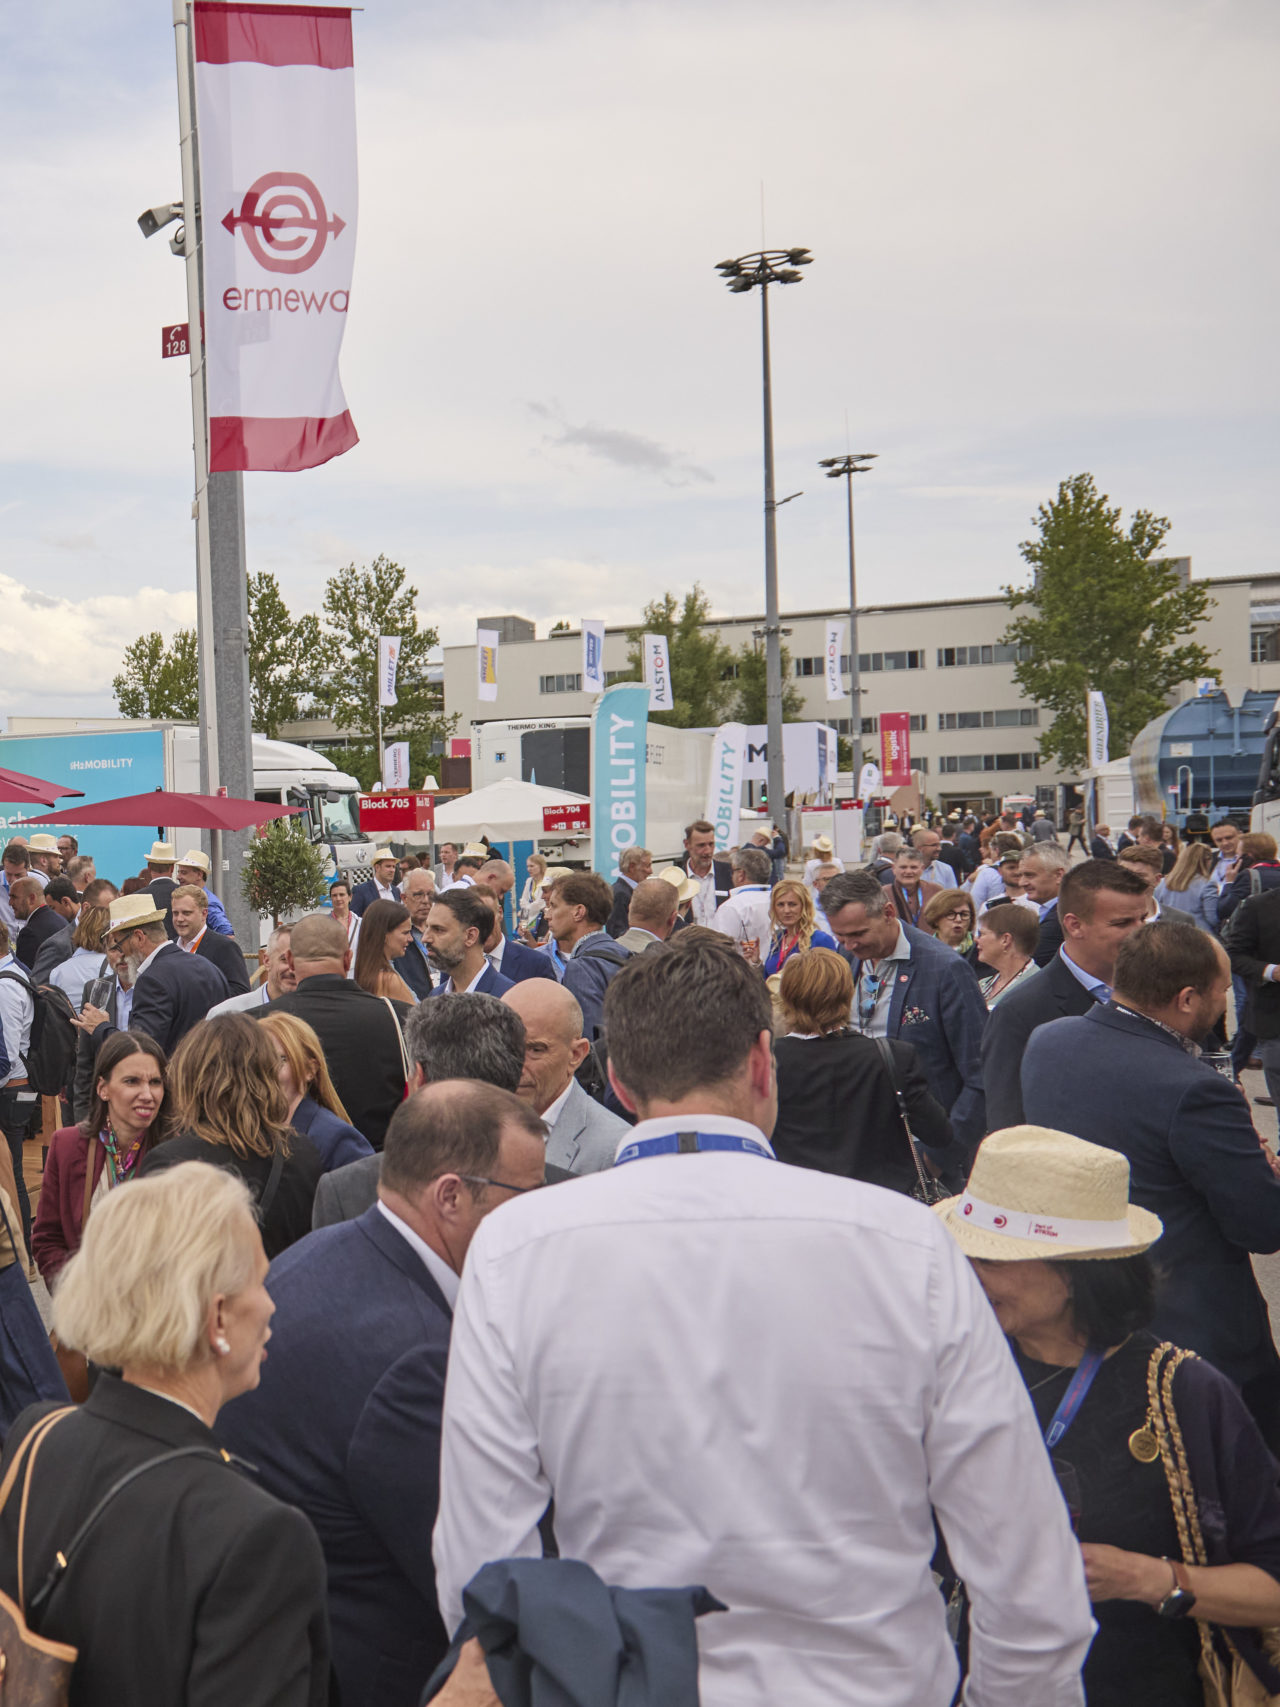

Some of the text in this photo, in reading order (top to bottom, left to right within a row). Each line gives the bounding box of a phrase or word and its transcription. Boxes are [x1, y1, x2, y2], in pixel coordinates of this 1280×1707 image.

[222, 287, 350, 315] ermewa
[166, 340, 186, 355] 128
[387, 658, 395, 696] MILLET
[653, 645, 665, 702] ALSTOM
[890, 730, 900, 760] logistic
[361, 798, 410, 809] Block 705
[544, 807, 564, 815] Block
